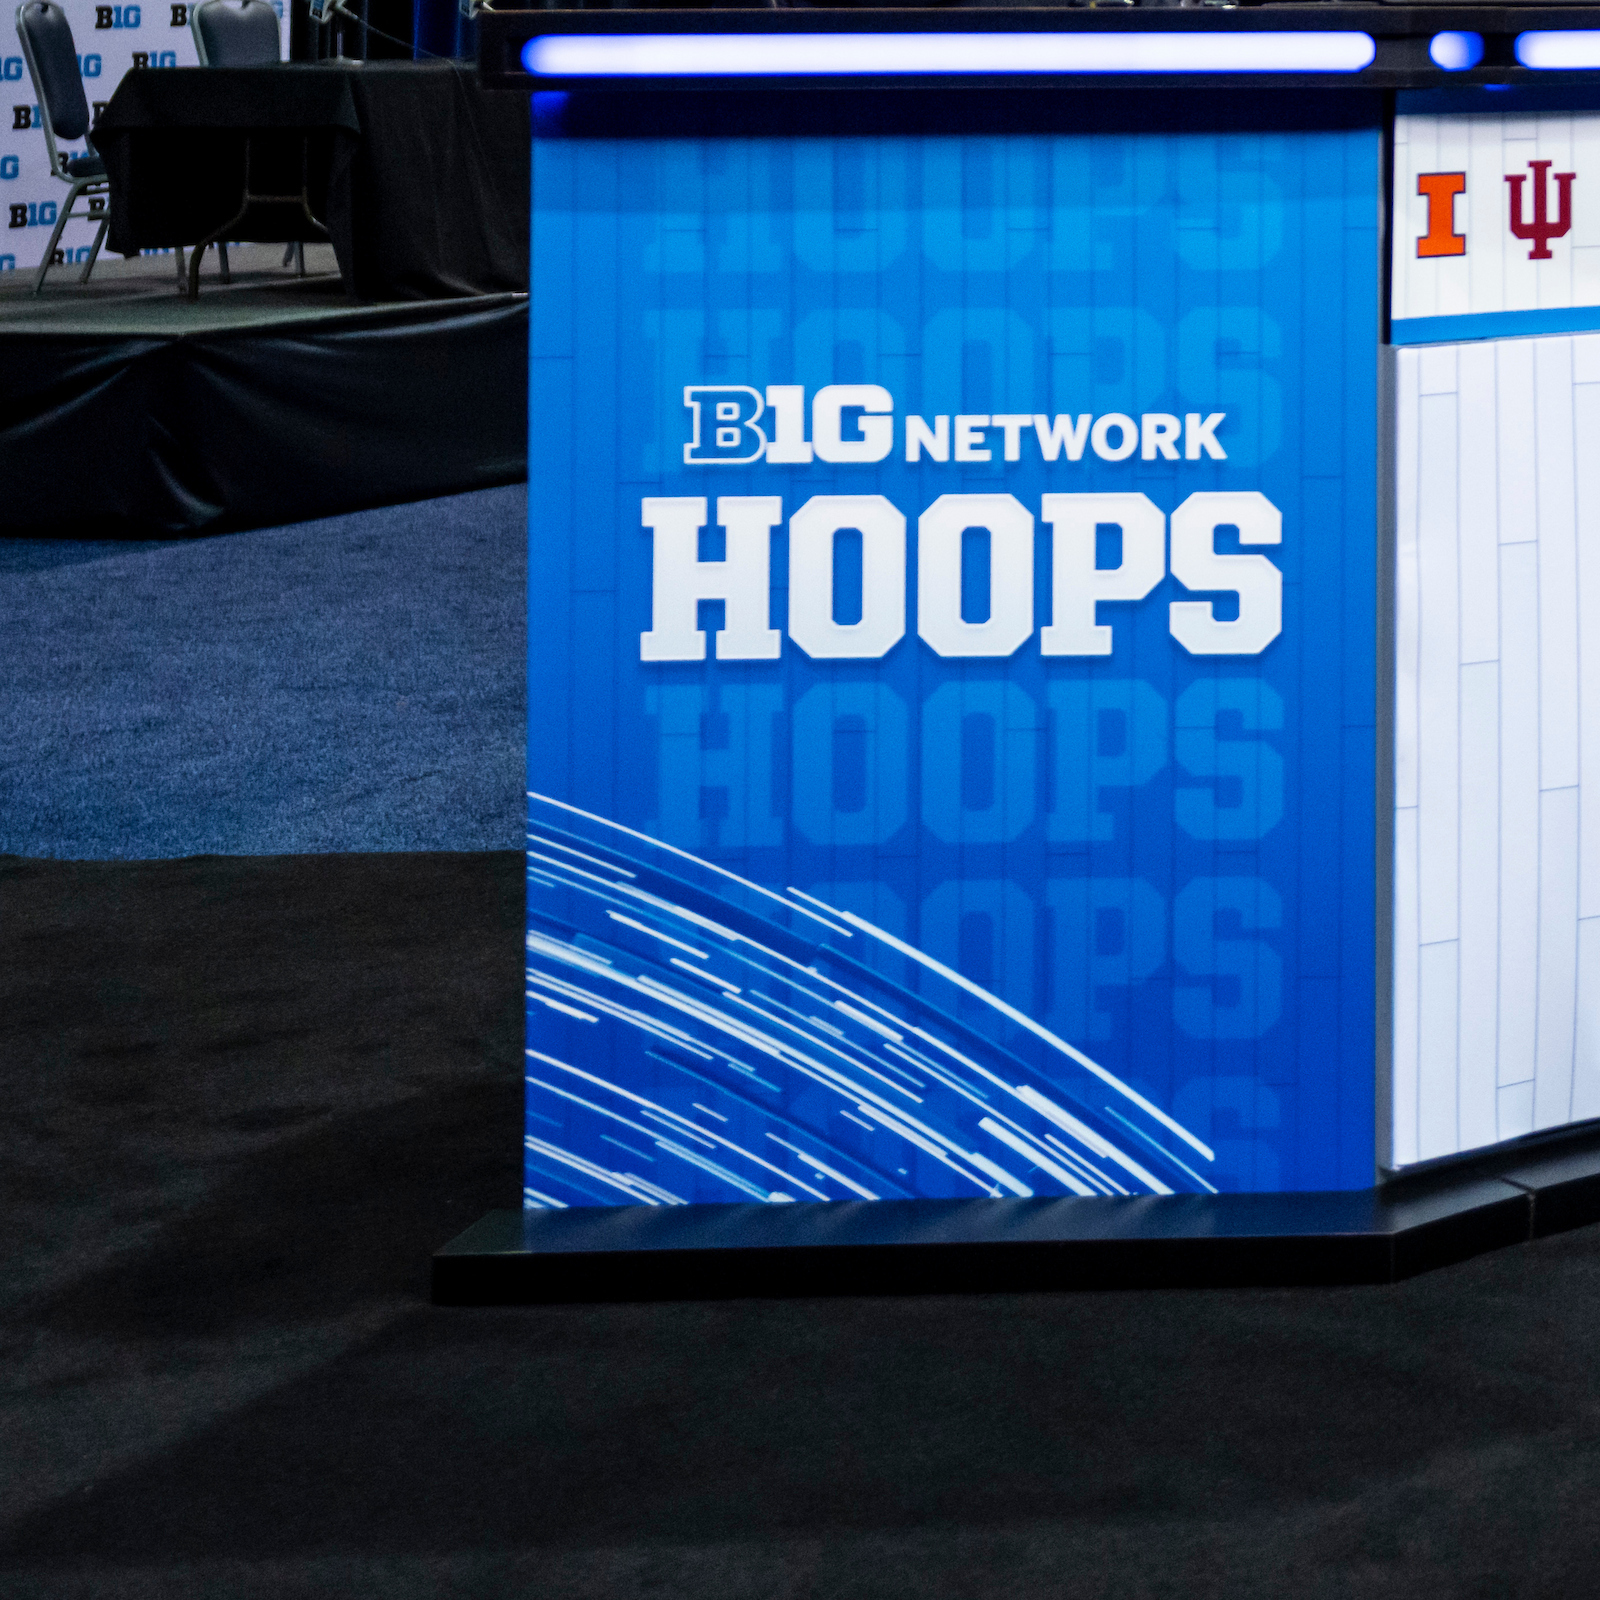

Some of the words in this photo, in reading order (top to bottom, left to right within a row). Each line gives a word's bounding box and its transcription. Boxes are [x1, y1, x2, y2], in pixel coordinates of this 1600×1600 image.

[95, 5, 141, 30] B1G
[13, 105, 41, 129] B1
[9, 201, 57, 228] B1G
[683, 384, 894, 465] B1G
[905, 411, 1229, 463] NETWORK
[640, 491, 1284, 662] HOOPS
[644, 677, 1284, 848] HOOPS
